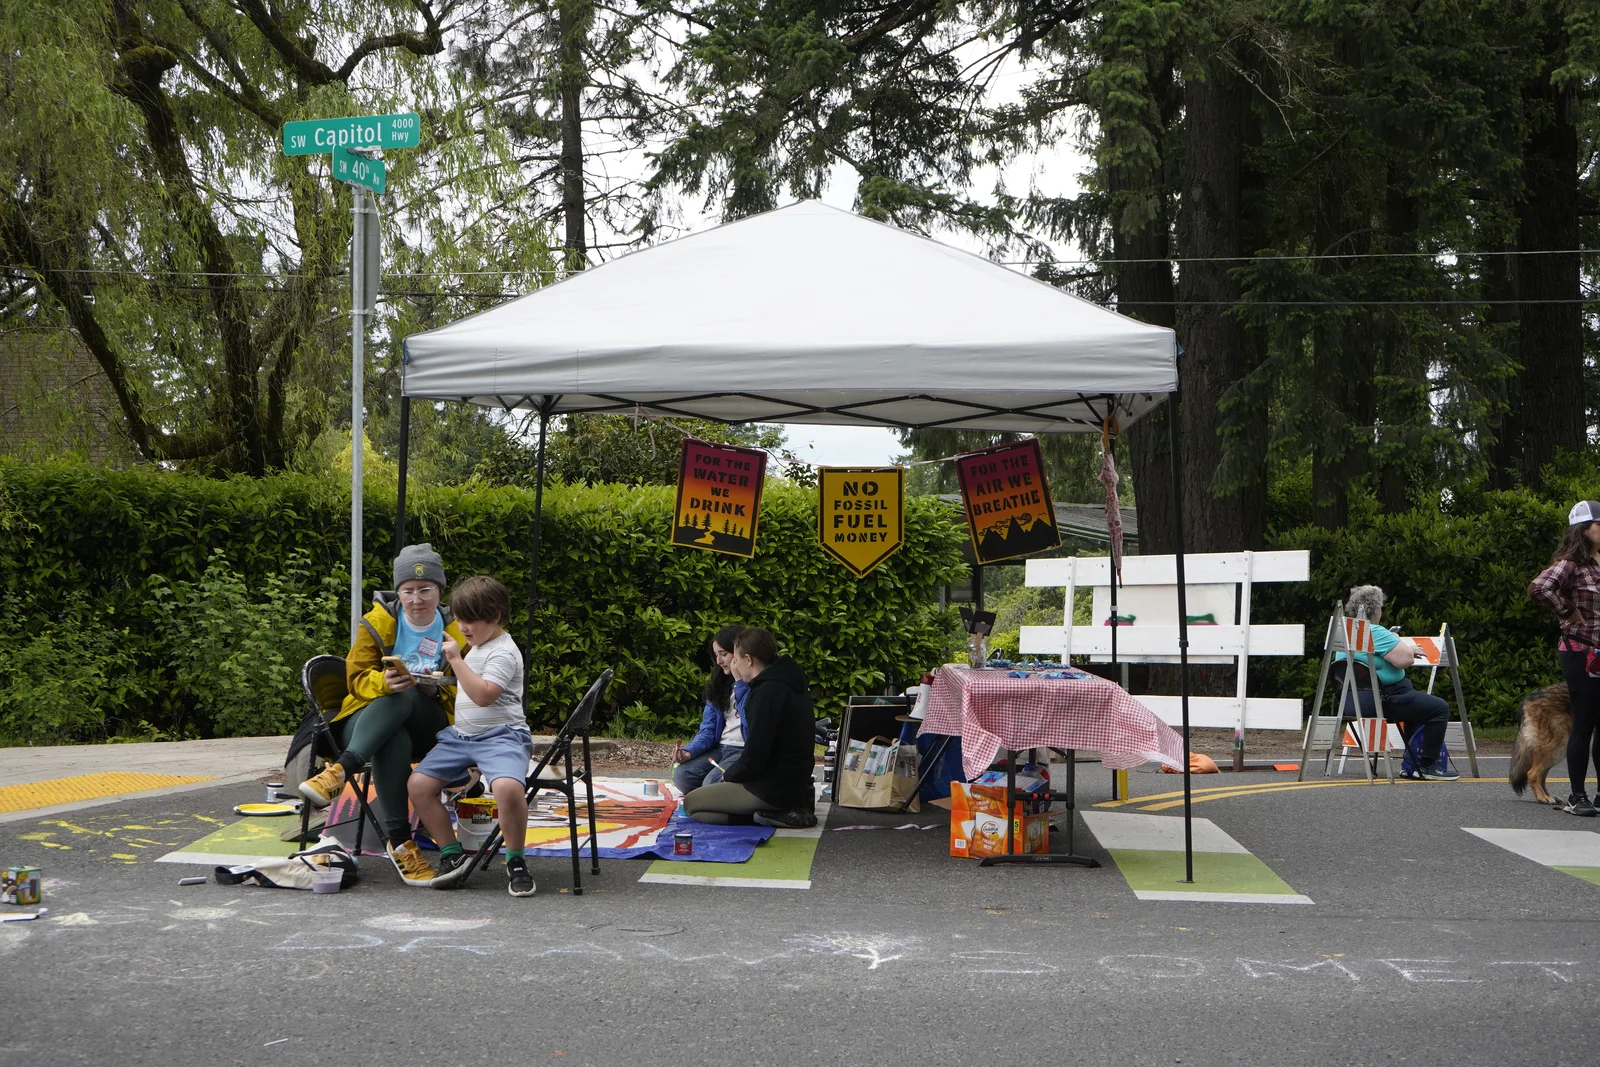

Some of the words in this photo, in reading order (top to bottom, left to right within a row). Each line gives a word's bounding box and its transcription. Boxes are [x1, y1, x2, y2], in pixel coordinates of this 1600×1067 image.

[392, 118, 414, 129] 4000
[291, 135, 306, 148] SW
[314, 122, 382, 146] Capitol
[391, 131, 409, 142] Hwy
[695, 454, 720, 467] FOR
[726, 458, 751, 472] THE
[970, 461, 998, 478] FOR
[1001, 455, 1029, 471] THE
[693, 467, 749, 488] WATER
[976, 479, 1004, 497] AIR
[1007, 472, 1033, 489] WE
[711, 486, 730, 498] WE
[843, 481, 879, 496] NO
[690, 497, 746, 517] DRINK
[834, 500, 888, 511] FOSSIL
[972, 489, 1041, 517] BREATHE
[833, 514, 888, 529] FUEL
[834, 532, 888, 543] MONEY
